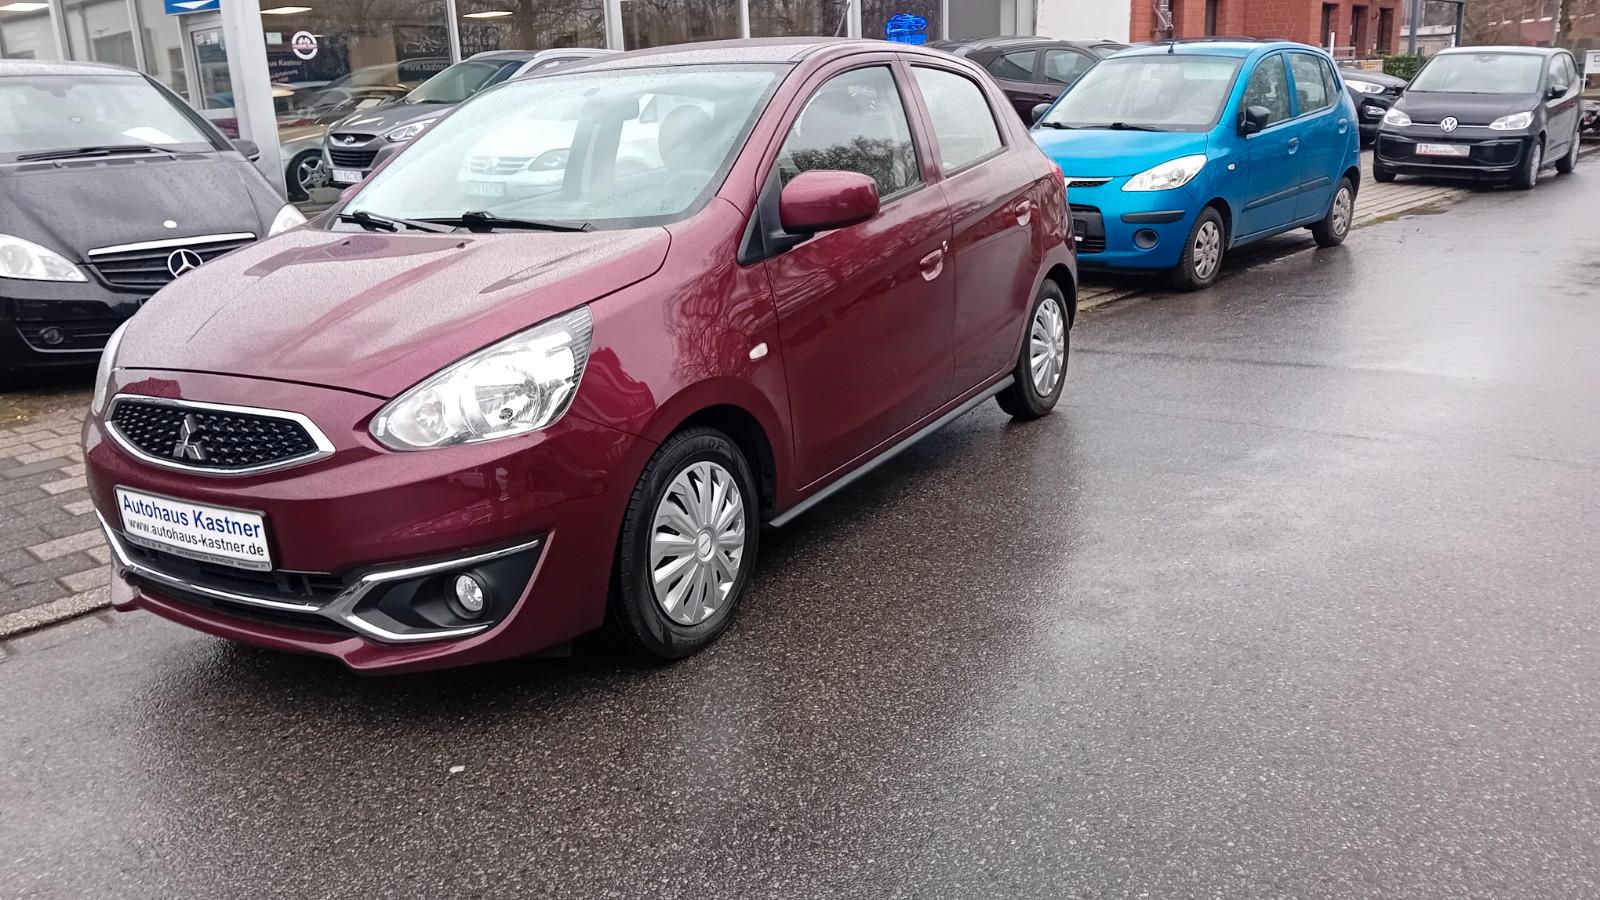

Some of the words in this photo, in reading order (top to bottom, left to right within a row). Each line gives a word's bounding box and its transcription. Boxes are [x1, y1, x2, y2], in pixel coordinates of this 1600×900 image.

[123, 494, 189, 526] Autohaus
[193, 509, 261, 538] Kastner
[128, 518, 265, 557] www.autohaus-kastner.de
